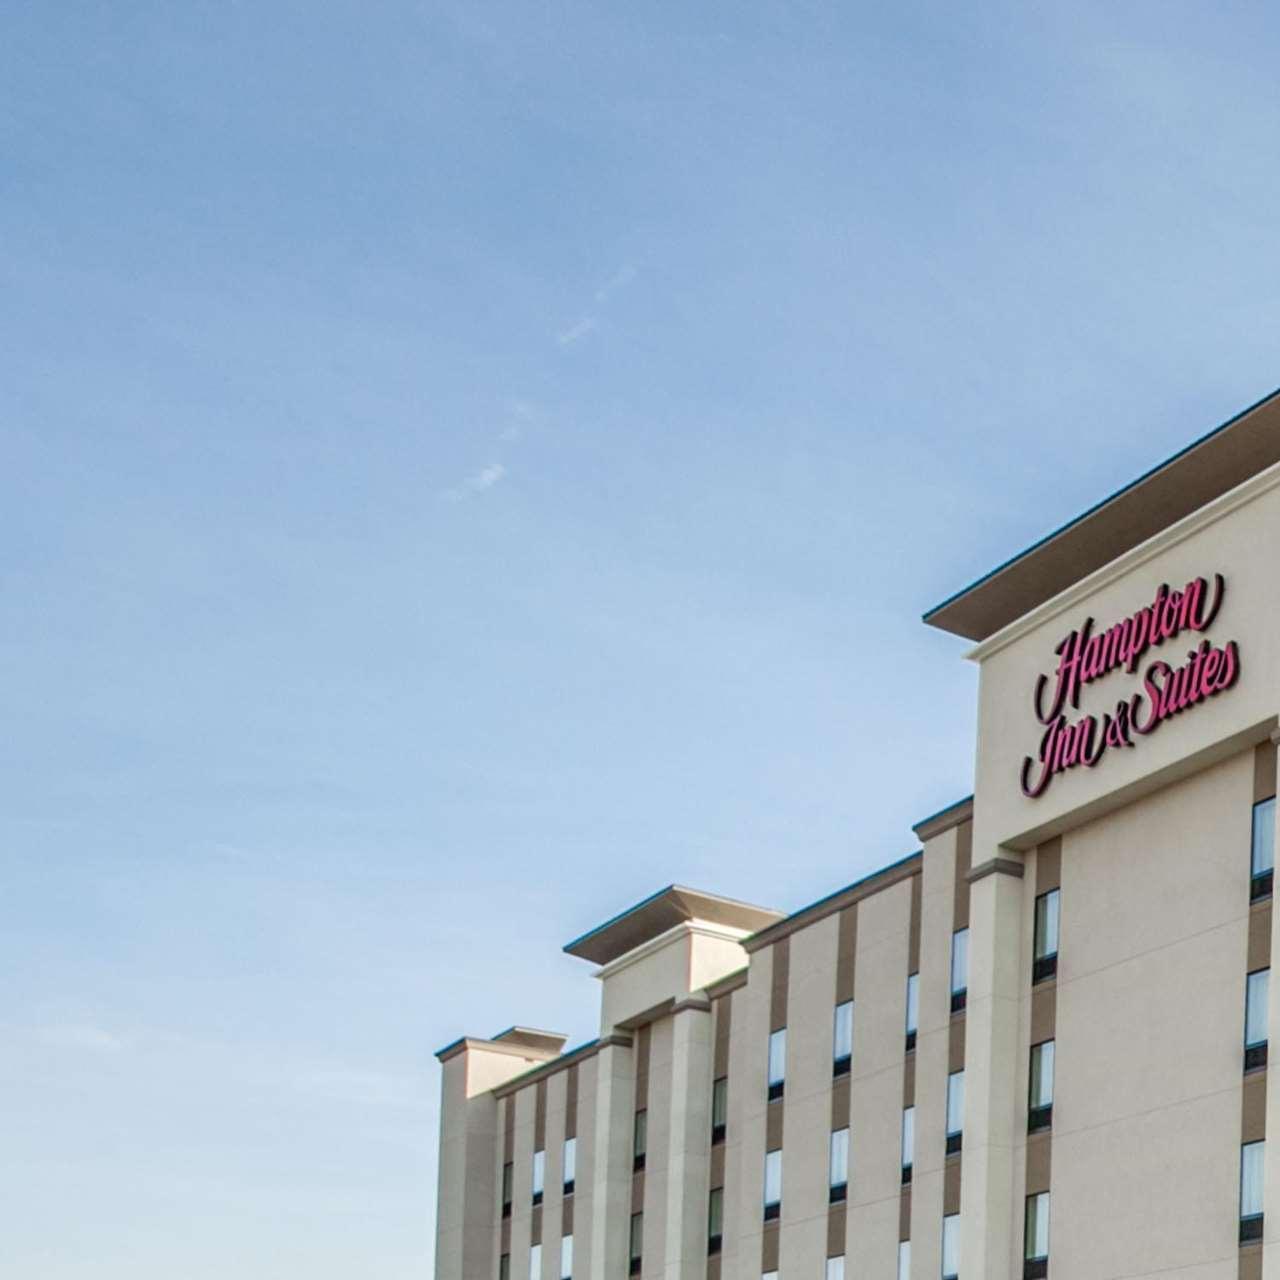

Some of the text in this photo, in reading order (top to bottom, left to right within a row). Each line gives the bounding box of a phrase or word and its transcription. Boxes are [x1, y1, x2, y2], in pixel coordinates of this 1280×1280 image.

[1020, 639, 1241, 798] Inn & Suites
[1034, 573, 1225, 725] Hampton
